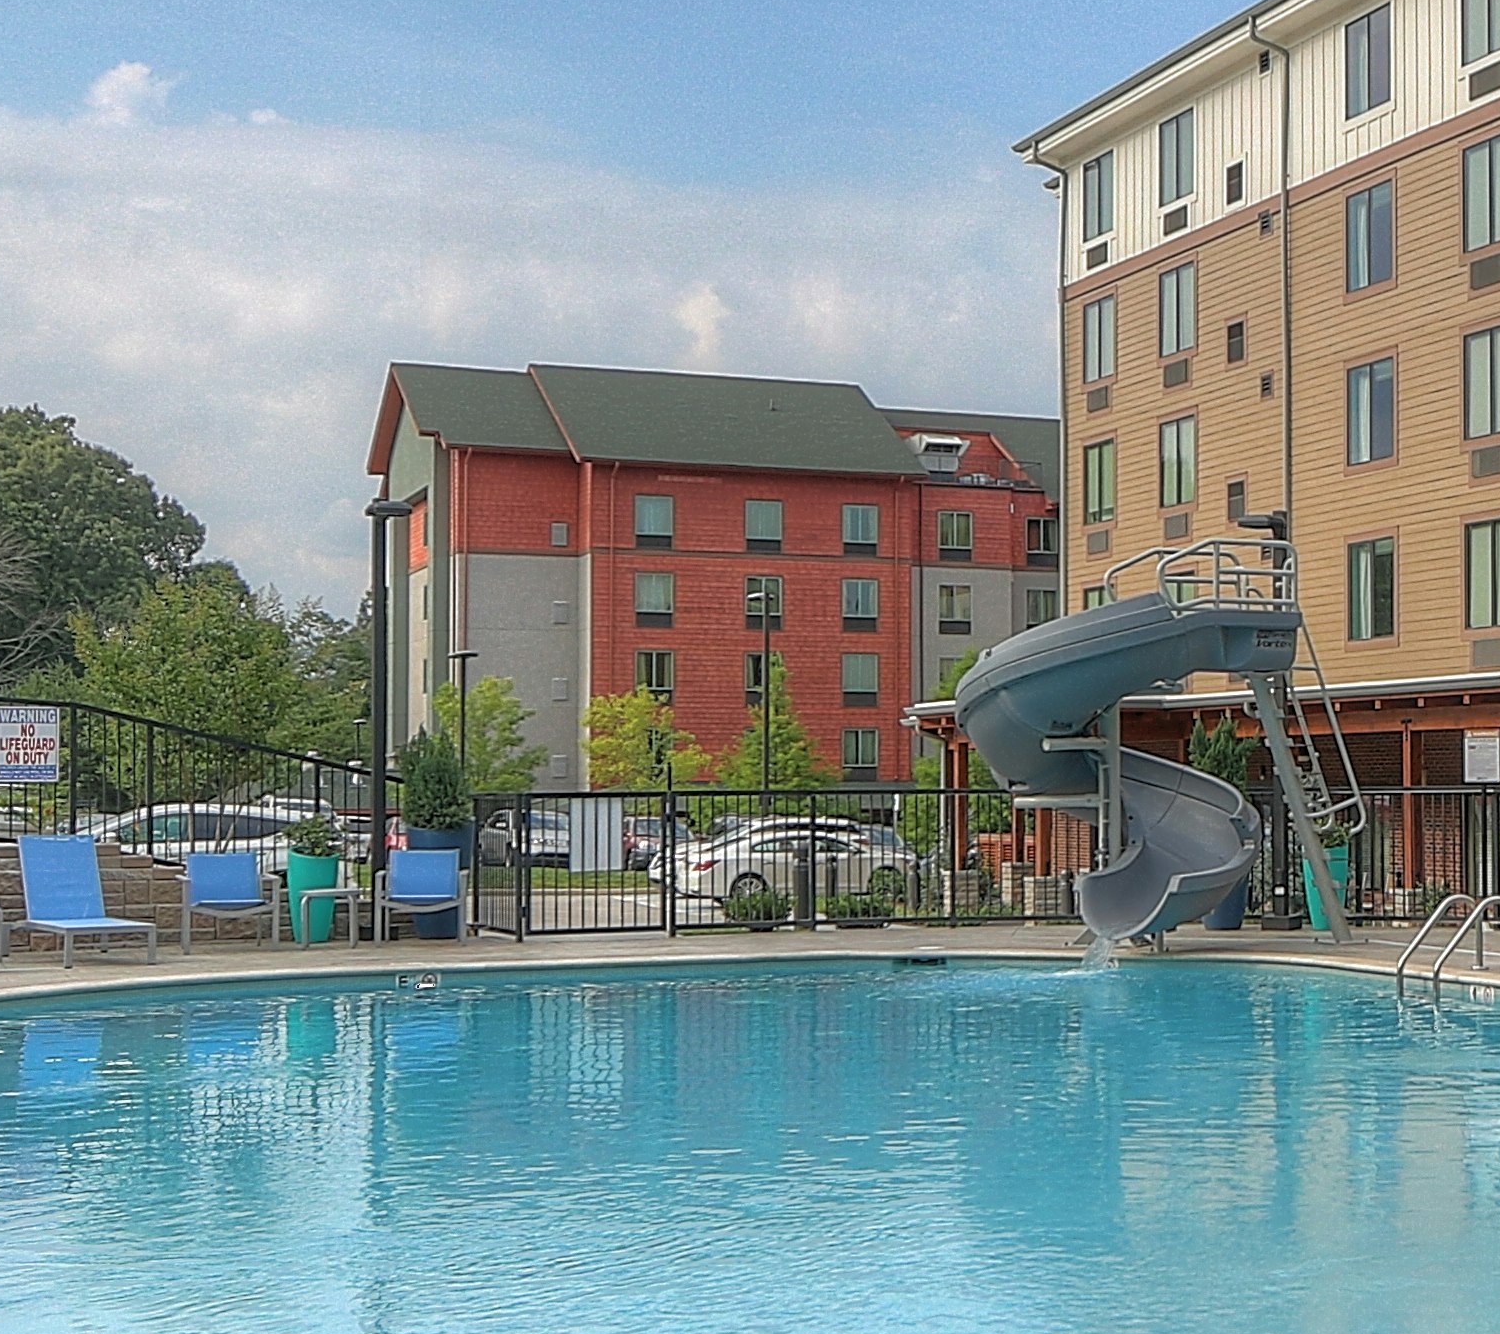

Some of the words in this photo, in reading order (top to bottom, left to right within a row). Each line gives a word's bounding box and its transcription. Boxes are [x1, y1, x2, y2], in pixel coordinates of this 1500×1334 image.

[0, 709, 56, 723] WARNING
[20, 724, 35, 737] NO
[0, 737, 56, 751] LIFEGUARD
[6, 751, 20, 764] ON
[23, 751, 49, 764] DUTY
